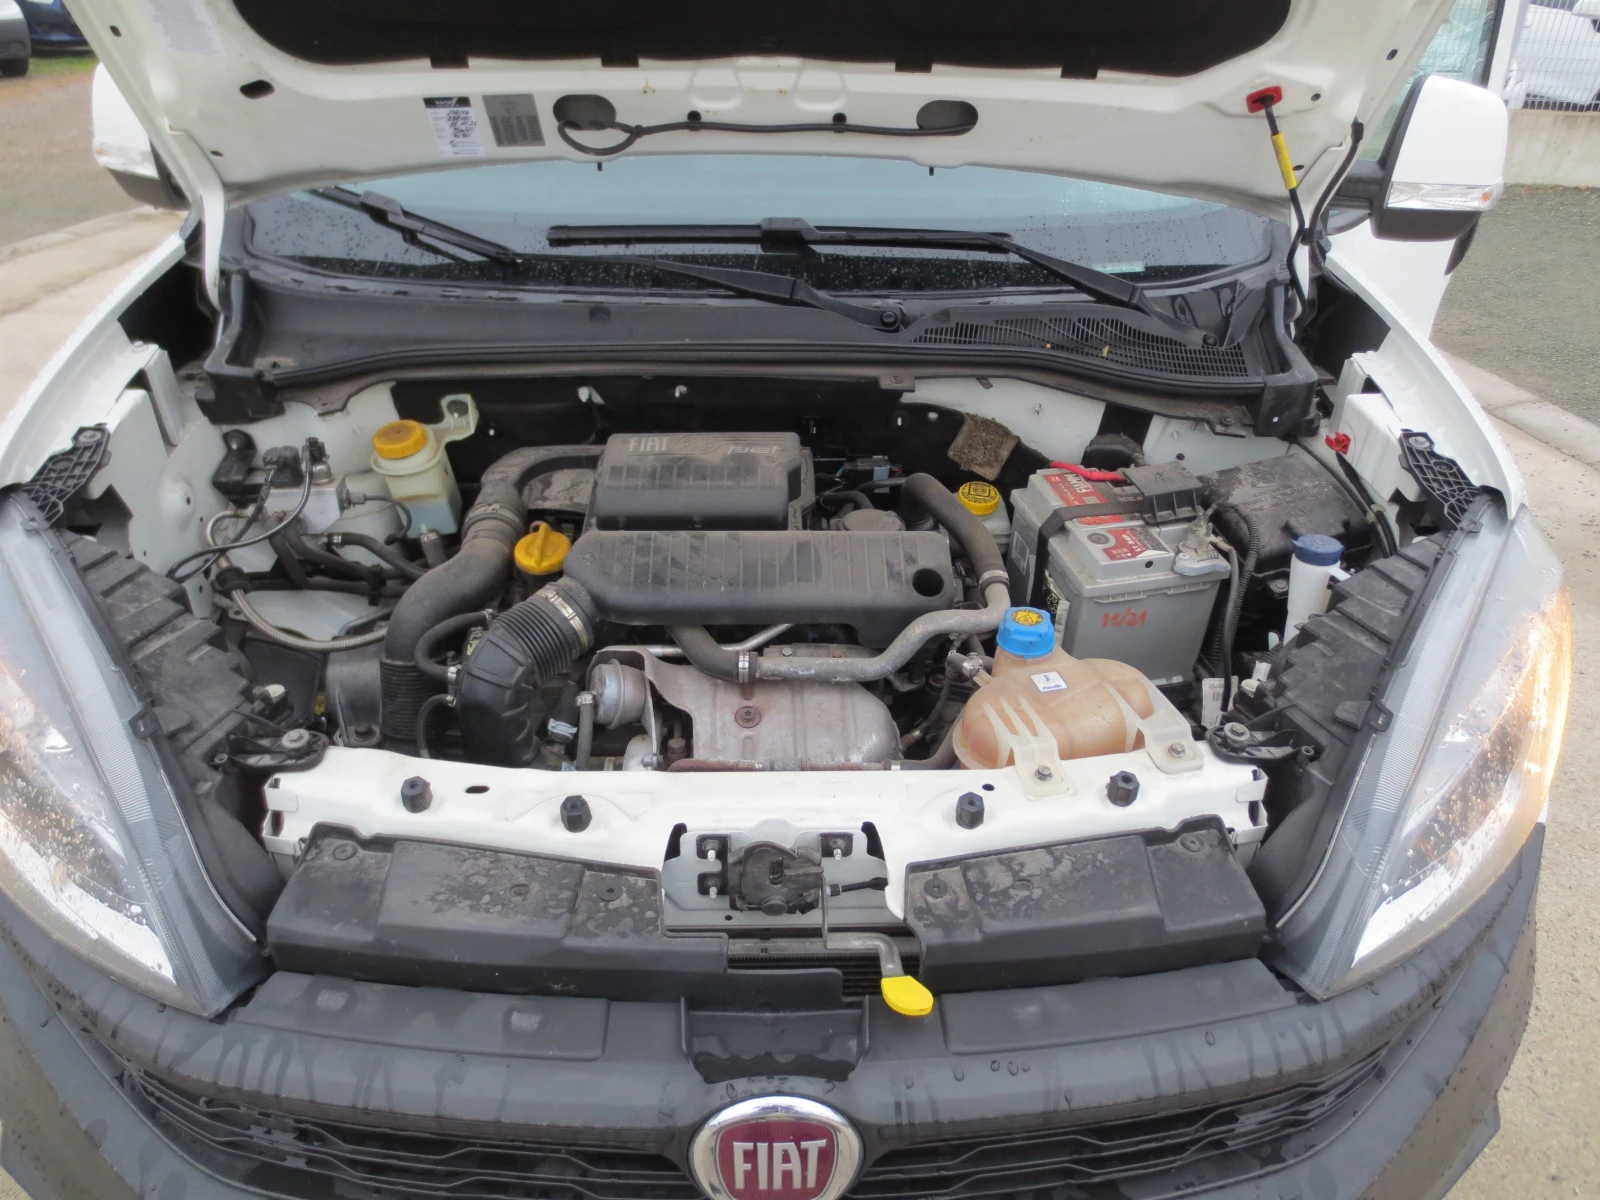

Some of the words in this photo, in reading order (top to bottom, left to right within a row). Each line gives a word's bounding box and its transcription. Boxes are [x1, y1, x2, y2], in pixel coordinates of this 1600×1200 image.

[628, 436, 669, 452] FIAT
[1101, 606, 1147, 628] 11/21
[732, 1139, 828, 1190] FIAT
